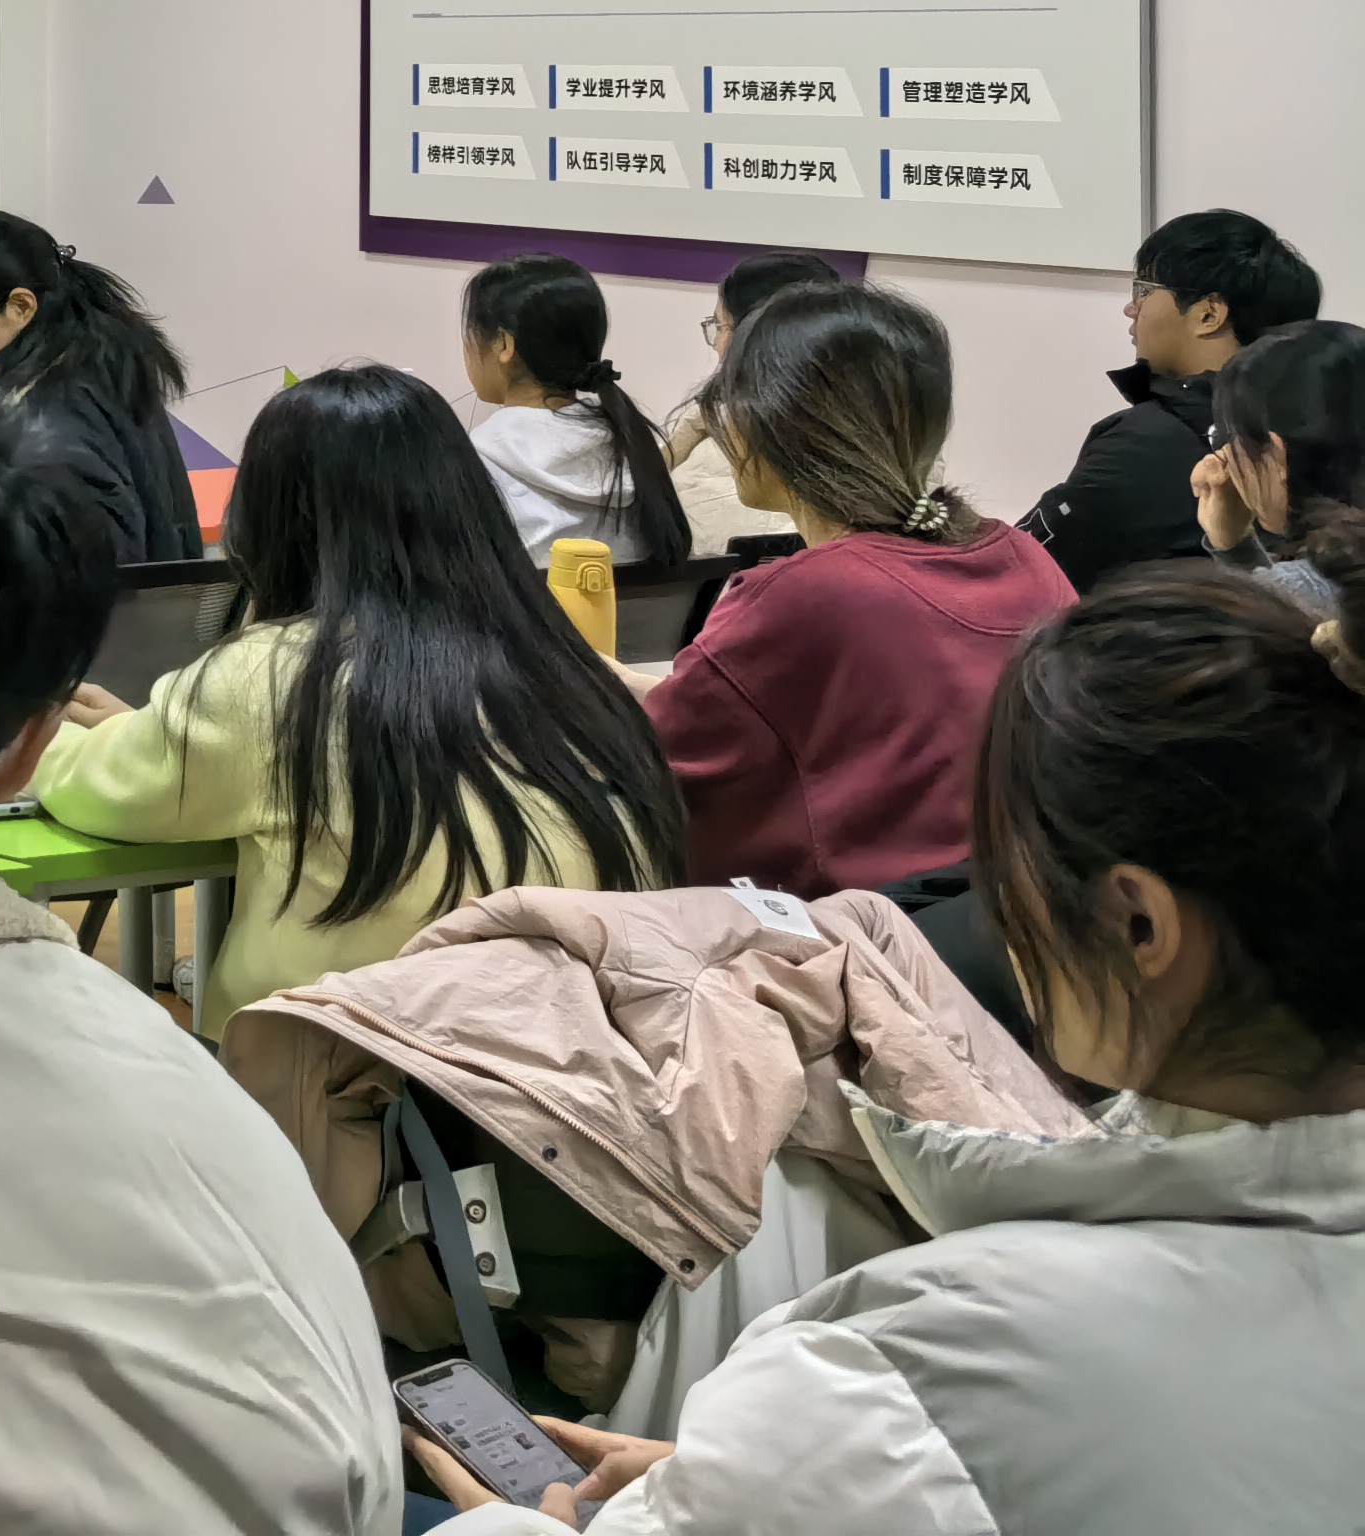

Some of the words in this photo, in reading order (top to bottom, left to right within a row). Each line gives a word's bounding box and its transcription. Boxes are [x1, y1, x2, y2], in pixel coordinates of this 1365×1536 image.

[427, 76, 516, 96] 思想培育学风
[566, 78, 666, 100] 学业提升学风
[723, 80, 836, 102] 环境涵养学风
[902, 80, 1031, 104] 管理塑造学风
[427, 145, 516, 167] 榜样引领学风
[566, 151, 666, 174] 队伍引导学风
[723, 157, 837, 183] 科创助力学风
[902, 164, 1031, 191] 制度保障学风
